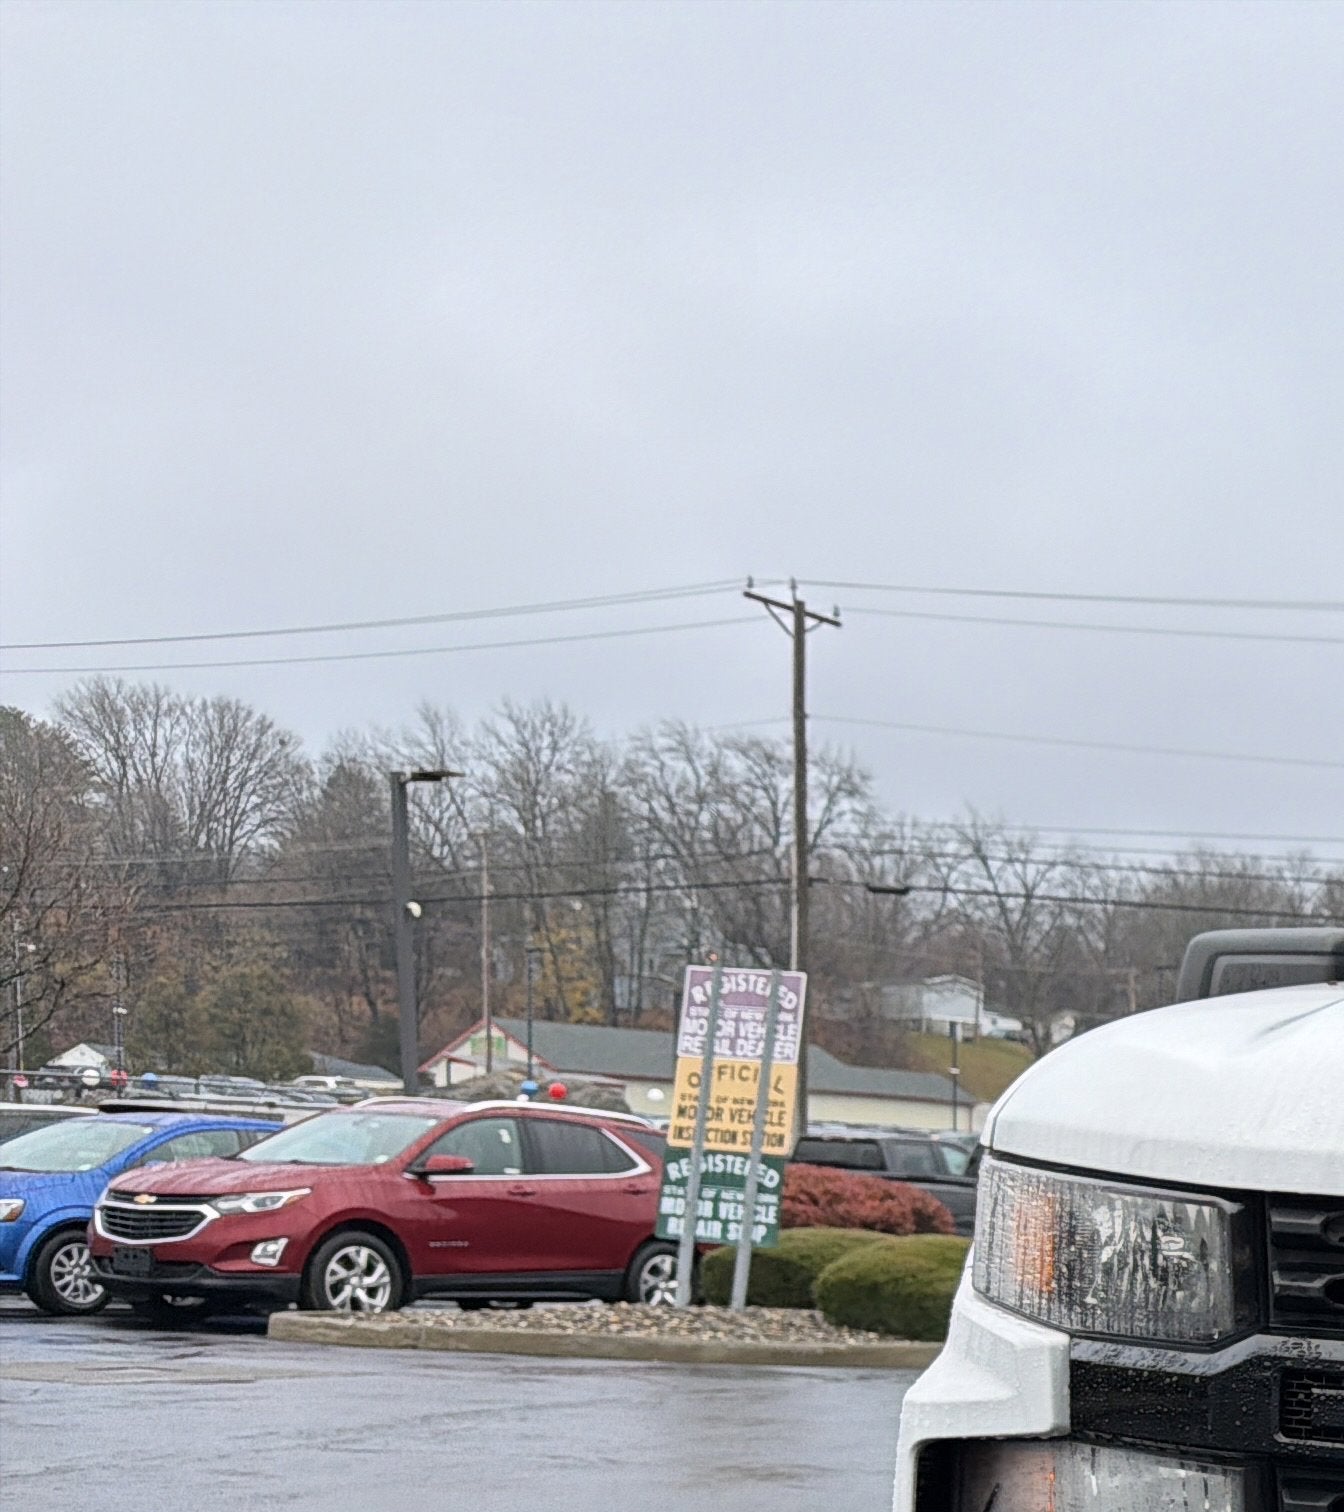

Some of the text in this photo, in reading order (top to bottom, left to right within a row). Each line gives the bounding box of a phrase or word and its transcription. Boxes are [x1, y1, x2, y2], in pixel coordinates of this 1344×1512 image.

[682, 1018, 736, 1038] MOOR
[736, 1039, 796, 1059] DEAER
[687, 1065, 784, 1095] OFICIL
[678, 1104, 723, 1122] MOOR
[673, 1126, 737, 1145] INSCTION
